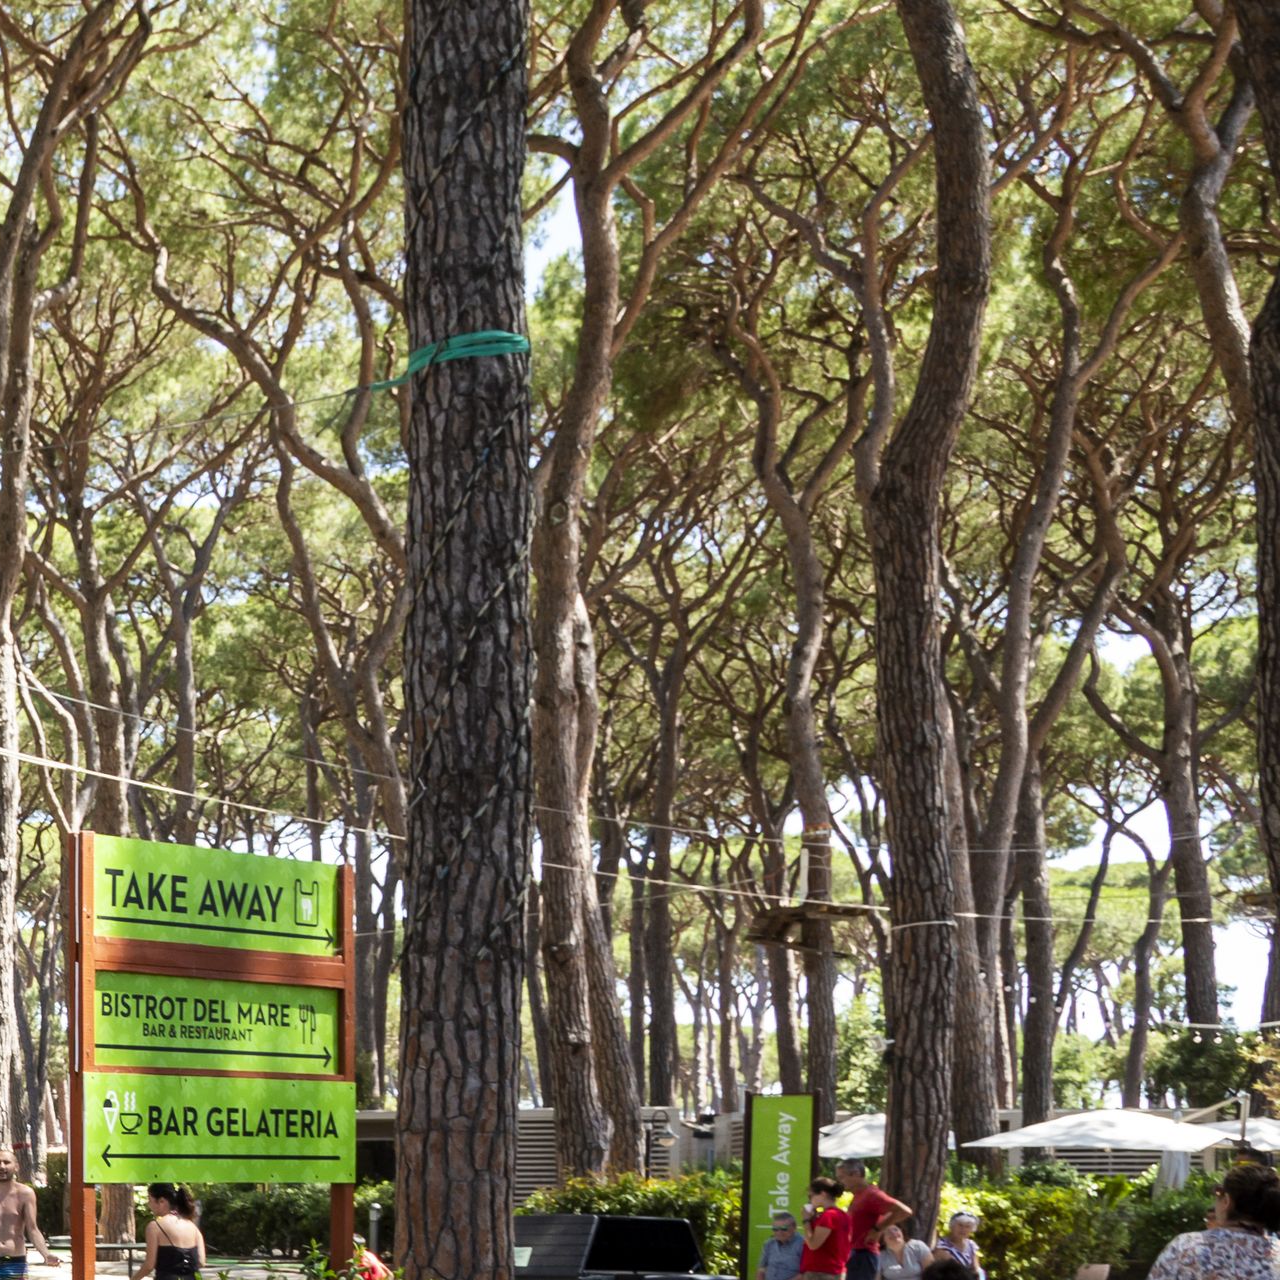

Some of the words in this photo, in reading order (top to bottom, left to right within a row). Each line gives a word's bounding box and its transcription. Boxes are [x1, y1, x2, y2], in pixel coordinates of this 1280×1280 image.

[104, 867, 188, 914] TAKE
[197, 879, 283, 923] AWAY
[101, 992, 187, 1021] BISTROT
[193, 998, 231, 1024] DEL
[237, 1001, 290, 1027] MARE
[142, 1022, 166, 1038] BAR
[169, 1024, 177, 1039] &
[180, 1025, 253, 1042] RESTAURANT
[148, 1105, 199, 1136] BAR
[206, 1106, 339, 1139] GELATERIA
[771, 1111, 798, 1165] Away
[768, 1171, 790, 1218] Take
